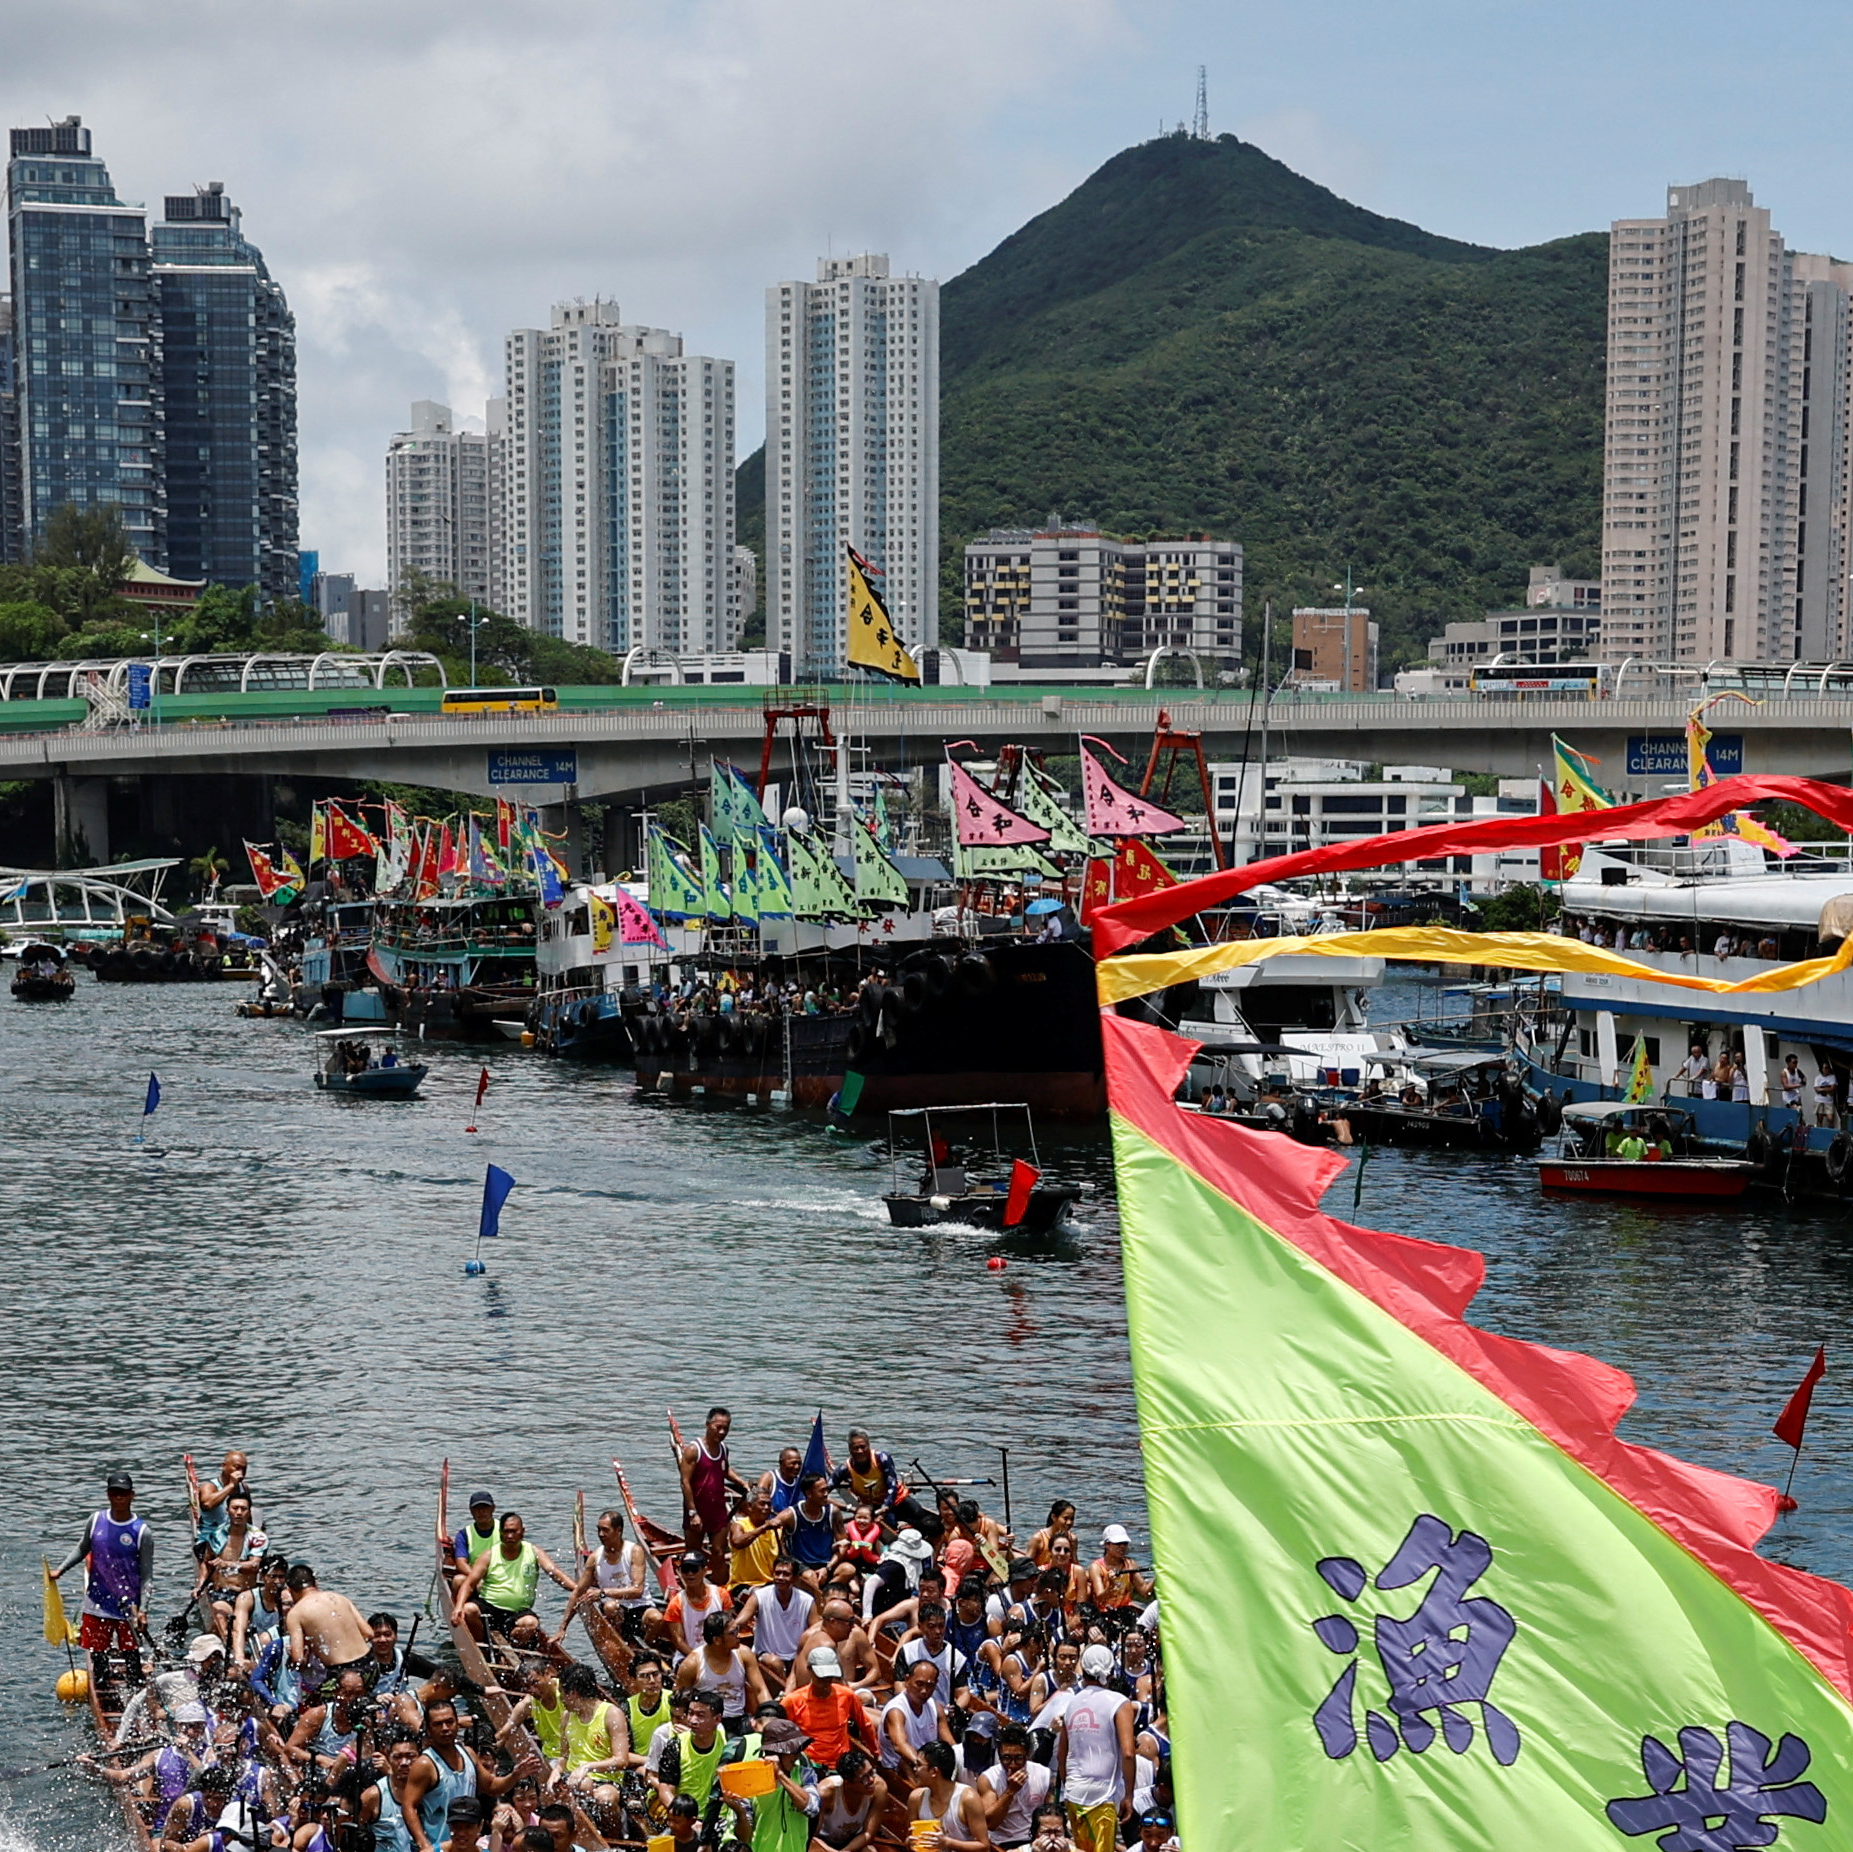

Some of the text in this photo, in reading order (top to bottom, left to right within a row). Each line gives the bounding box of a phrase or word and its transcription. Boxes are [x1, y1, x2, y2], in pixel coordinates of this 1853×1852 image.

[1716, 749, 1739, 761] 14M
[497, 756, 543, 767] CHANNEL
[555, 761, 574, 772] 14M
[490, 768, 550, 780] CLEARANCE
